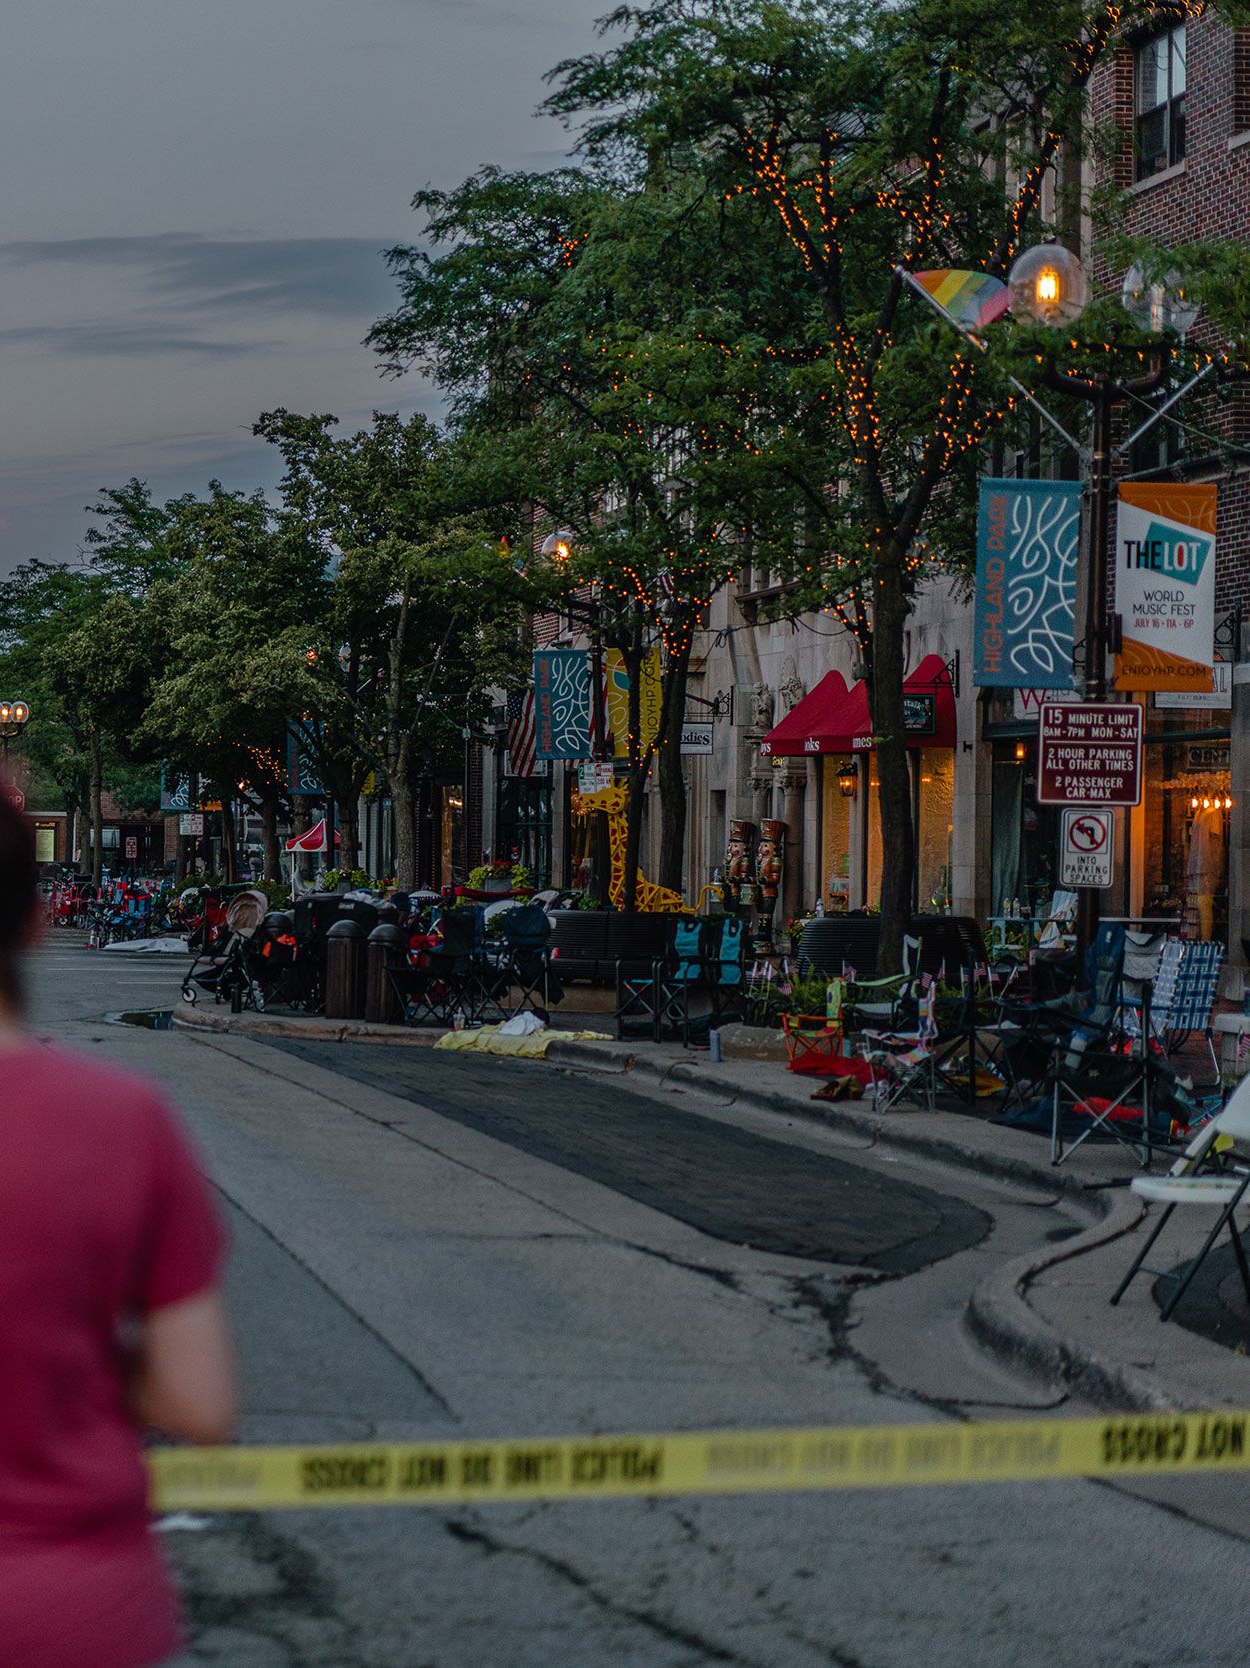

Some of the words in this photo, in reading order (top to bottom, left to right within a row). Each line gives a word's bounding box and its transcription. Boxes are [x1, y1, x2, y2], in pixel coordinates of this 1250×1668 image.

[986, 495, 1007, 550] PARK
[1143, 590, 1185, 602] WORLD
[982, 559, 1005, 672] HIGHLAND
[1132, 603, 1167, 615] MUSIC
[1170, 604, 1196, 616] FEST
[1133, 617, 1149, 628] JULY
[1121, 664, 1207, 677] ENJOYHP.COM
[1049, 709, 1063, 724] 15
[1068, 713, 1104, 725] MINUTE
[1108, 714, 1134, 725] LIMIT
[1043, 726, 1085, 738] 8AM-7PM
[1091, 727, 1139, 738] MON-SAT
[1048, 748, 1055, 758] 2
[1057, 748, 1085, 759] HOUR
[1089, 749, 1133, 760] PARKING
[1046, 759, 1064, 769] ALL
[1068, 759, 1100, 770] OTHER
[1105, 760, 1134, 771] TIMES
[1055, 776, 1062, 787] 2
[1065, 776, 1123, 788] PASSENGER
[1077, 856, 1097, 865] INTO
[1065, 865, 1109, 875] PARKING
[1070, 874, 1103, 884] SPACES
